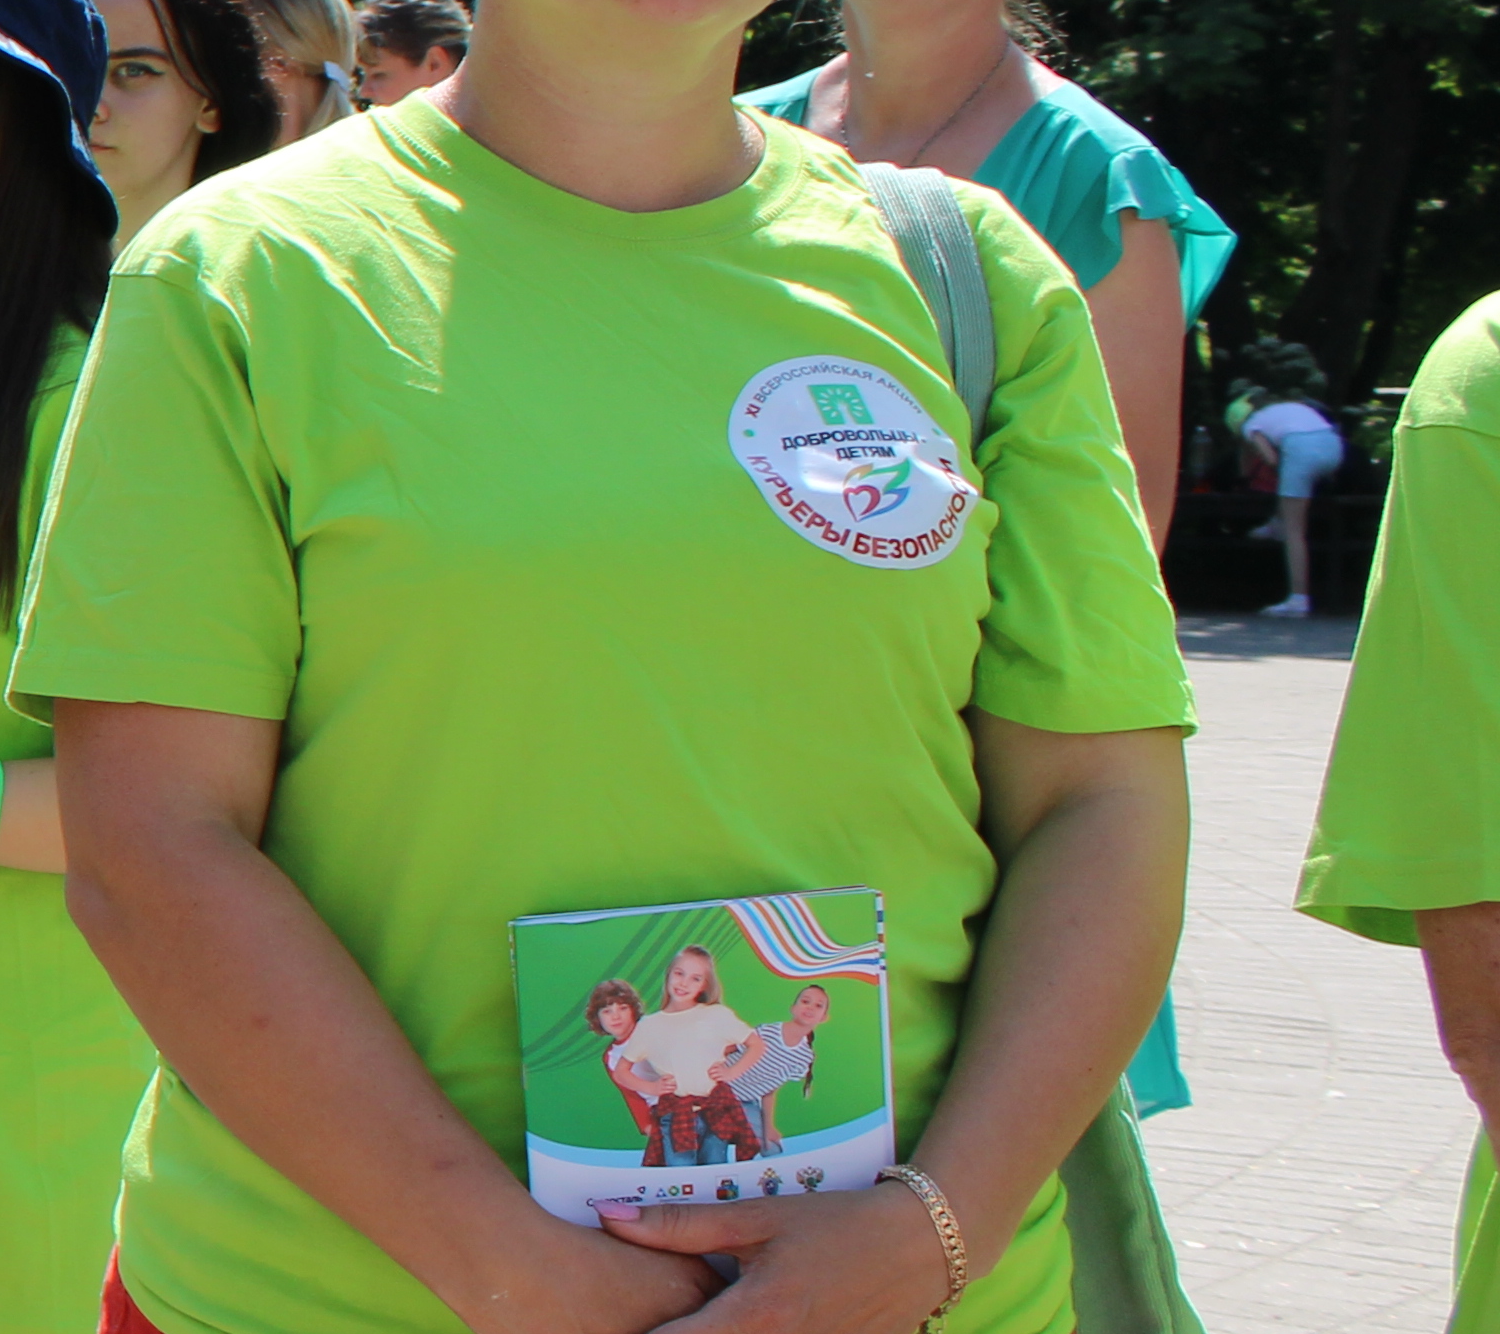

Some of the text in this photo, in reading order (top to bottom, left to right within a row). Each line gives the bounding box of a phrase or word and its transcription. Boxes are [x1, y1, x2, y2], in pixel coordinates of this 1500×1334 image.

[755, 362, 873, 404] ВСЕРОССИЙСКАЯ
[781, 428, 919, 451] ДОБРОВОЛЬЦЫ
[835, 446, 897, 461] ДЕТЯМ
[747, 455, 851, 546] КУРЬЕРЫ
